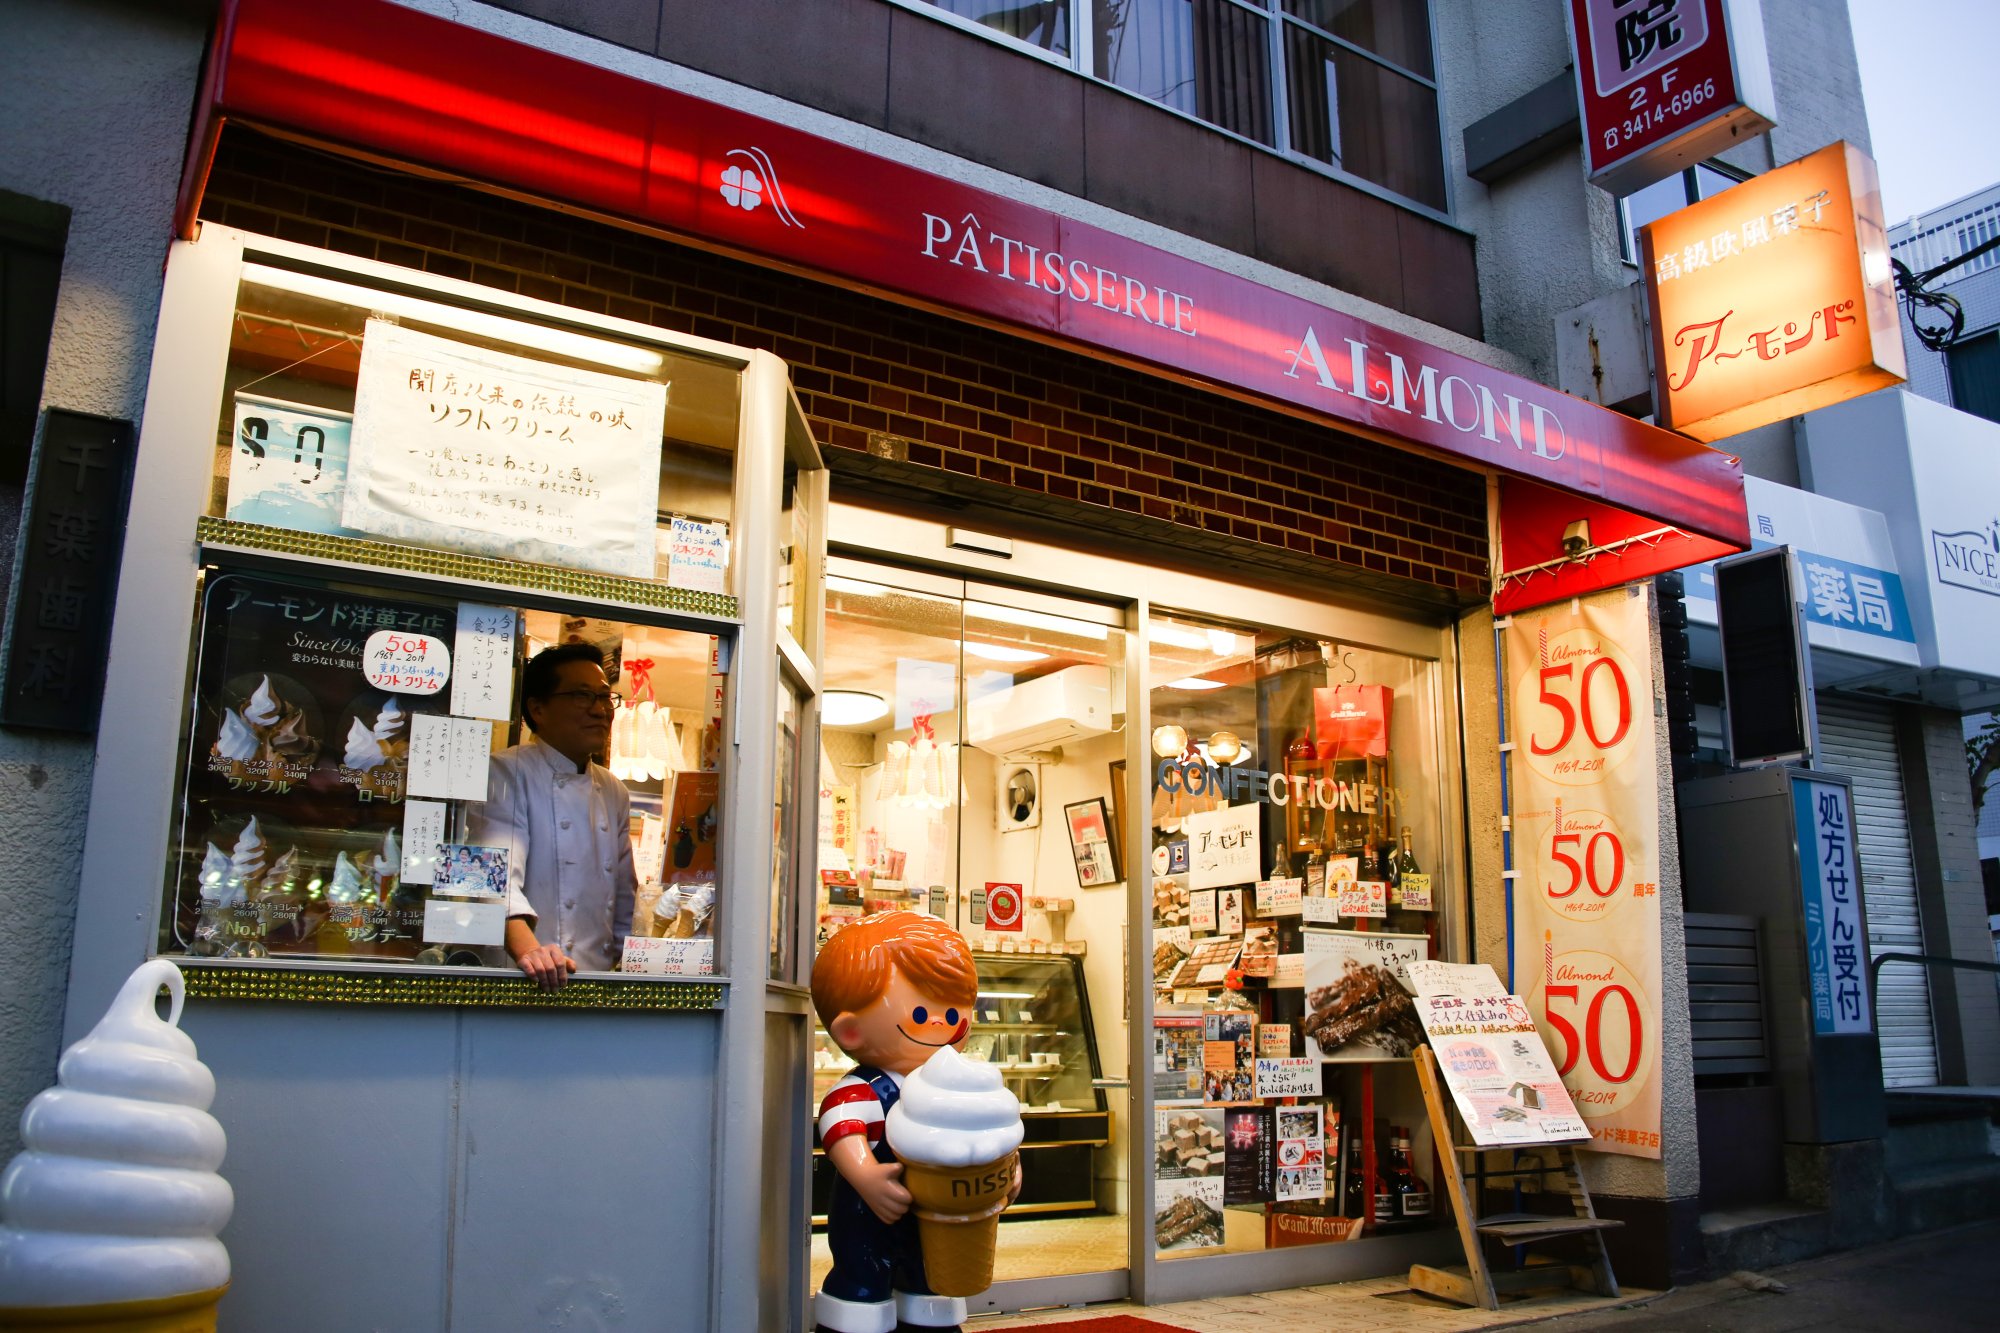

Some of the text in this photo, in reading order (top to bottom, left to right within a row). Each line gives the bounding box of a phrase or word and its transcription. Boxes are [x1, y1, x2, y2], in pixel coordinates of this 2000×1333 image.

[1623, 78, 1715, 142] 3414-6966
[1655, 189, 1832, 285] 高級欧風菓子
[920, 211, 1566, 461] PÂTISSERIE ALMOND
[1667, 300, 1857, 391] アーモンド
[24, 443, 108, 702] 千葉歯科
[1941, 541, 1998, 579] NICE
[1551, 643, 1602, 663] Almond
[1530, 657, 1633, 757] 50
[228, 776, 292, 795] ワッフル
[1563, 819, 1605, 832] Almond
[1547, 831, 1657, 899] 50 周年
[1564, 902, 1606, 913] 1969-2019
[1817, 790, 1861, 1022] 処方せん受付
[224, 920, 267, 937] No.1
[345, 927, 413, 944] サンデー
[1364, 939, 1394, 952] 小枝の
[1555, 964, 1616, 982] Almond
[1806, 901, 1831, 1021] ミノリ薬局
[1429, 1009, 1508, 1024] スイス仕込みの
[1545, 984, 1643, 1084] 50
[1278, 1213, 1309, 1233] Grand
